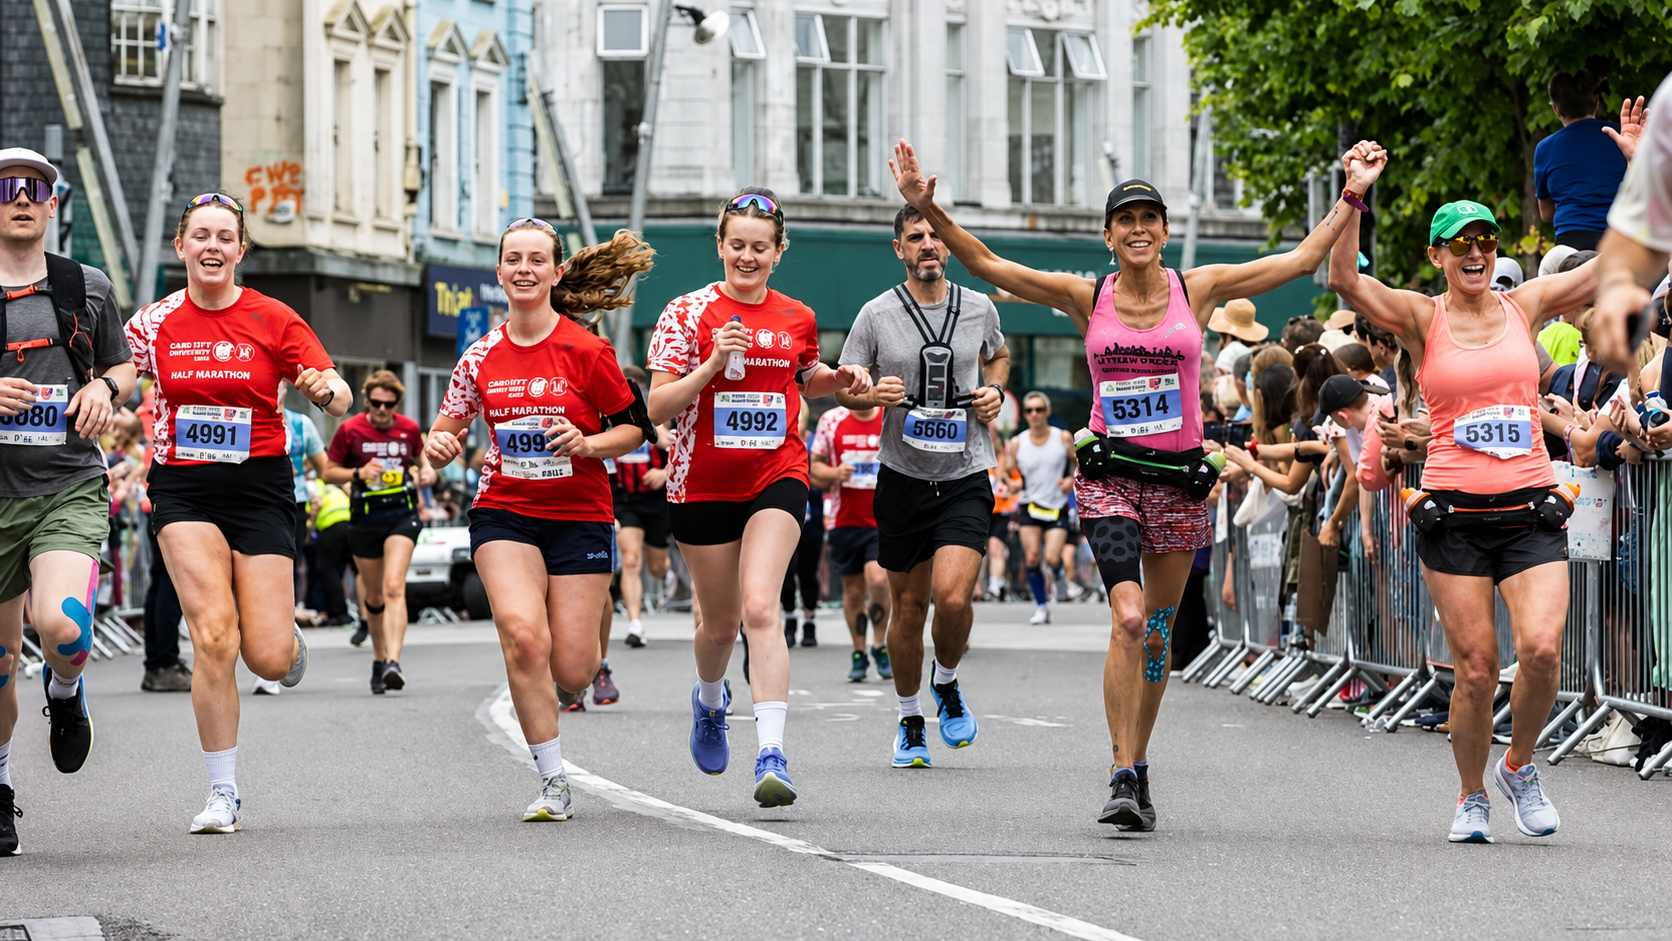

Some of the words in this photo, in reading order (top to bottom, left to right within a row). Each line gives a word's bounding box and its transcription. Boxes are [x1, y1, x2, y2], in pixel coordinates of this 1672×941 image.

[171, 371, 195, 380] HALF
[196, 370, 251, 380] MARATHON
[489, 407, 510, 417] HALF
[512, 406, 565, 415] MARATHON
[1113, 394, 1169, 420] 5314
[726, 410, 778, 432] 4992
[913, 420, 957, 439] 5660
[186, 423, 236, 446] 4991
[506, 432, 546, 453] 499
[1466, 422, 1520, 443] 5315
